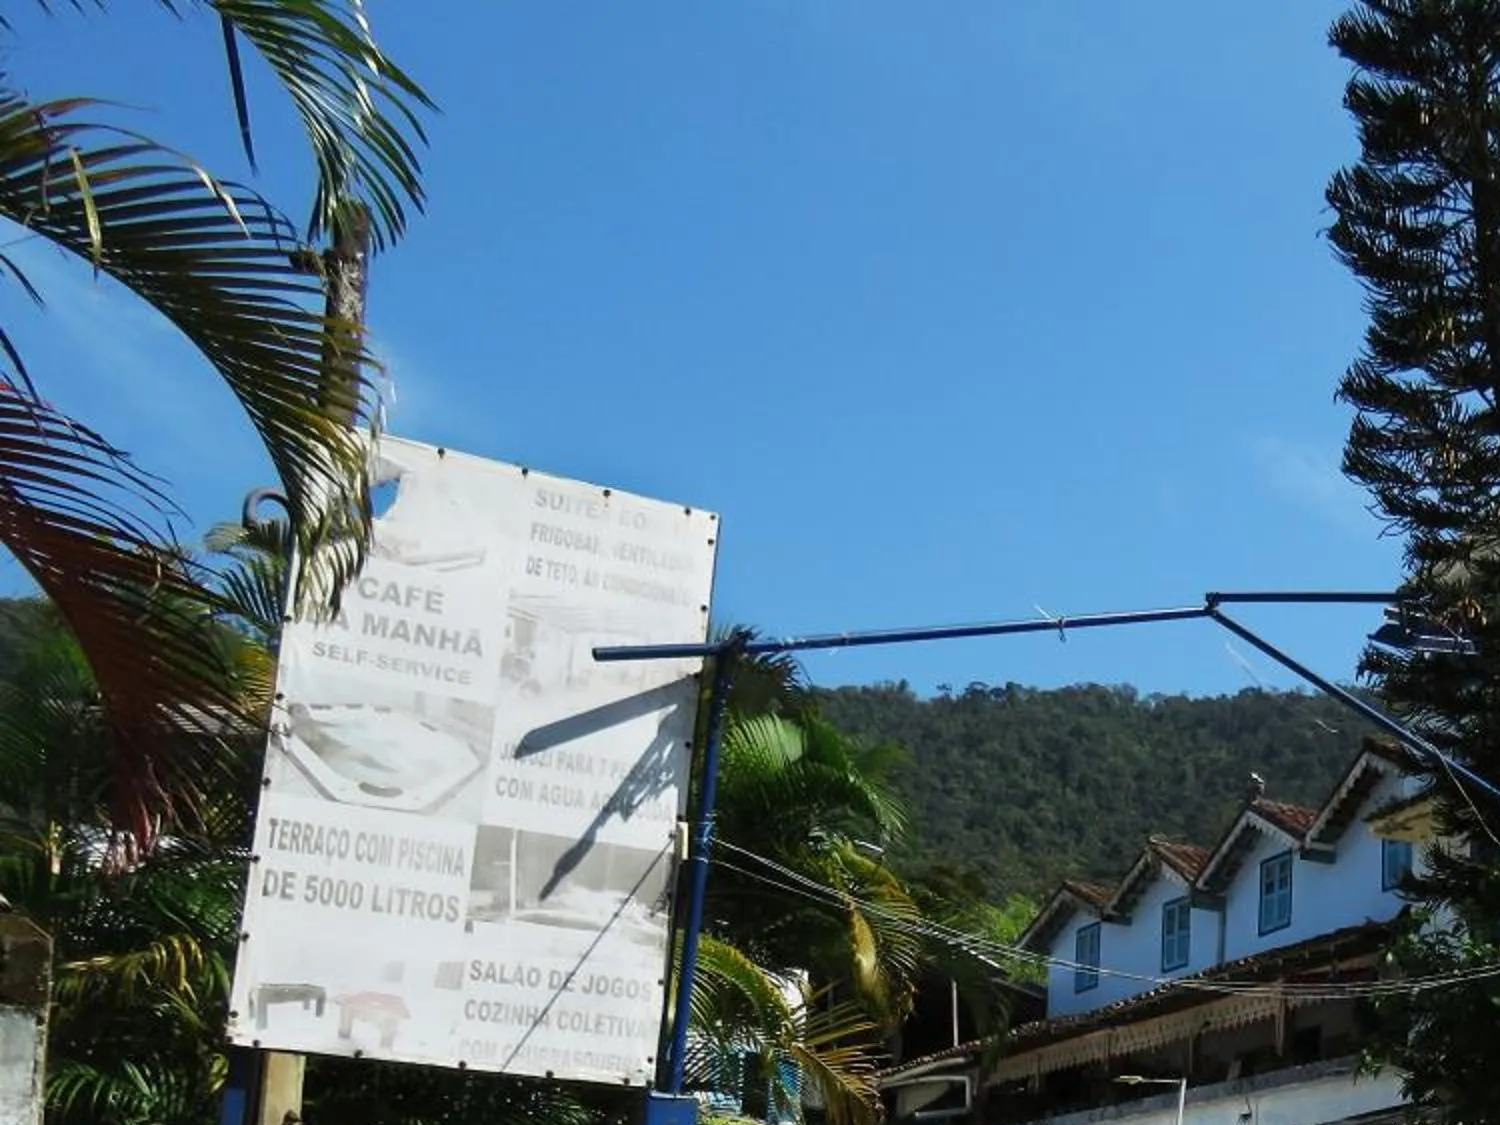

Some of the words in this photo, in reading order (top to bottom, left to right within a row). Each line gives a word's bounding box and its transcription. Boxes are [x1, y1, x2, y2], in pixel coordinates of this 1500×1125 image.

[534, 487, 609, 519] SUITE
[526, 555, 543, 577] DE
[357, 576, 445, 615] CAFÉ
[362, 612, 483, 658] MANHÃ
[311, 641, 473, 686] SELF-SERVICE
[495, 775, 533, 800] COM
[267, 817, 350, 865] TERRAÇO
[354, 831, 393, 867] COM
[398, 838, 466, 877] PISCINA
[262, 868, 297, 901] DE
[303, 874, 364, 911] 5000
[371, 884, 460, 923] LITROS
[548, 969, 576, 992] DE
[581, 975, 653, 1002] JOGOS
[464, 999, 551, 1029] COZINHA
